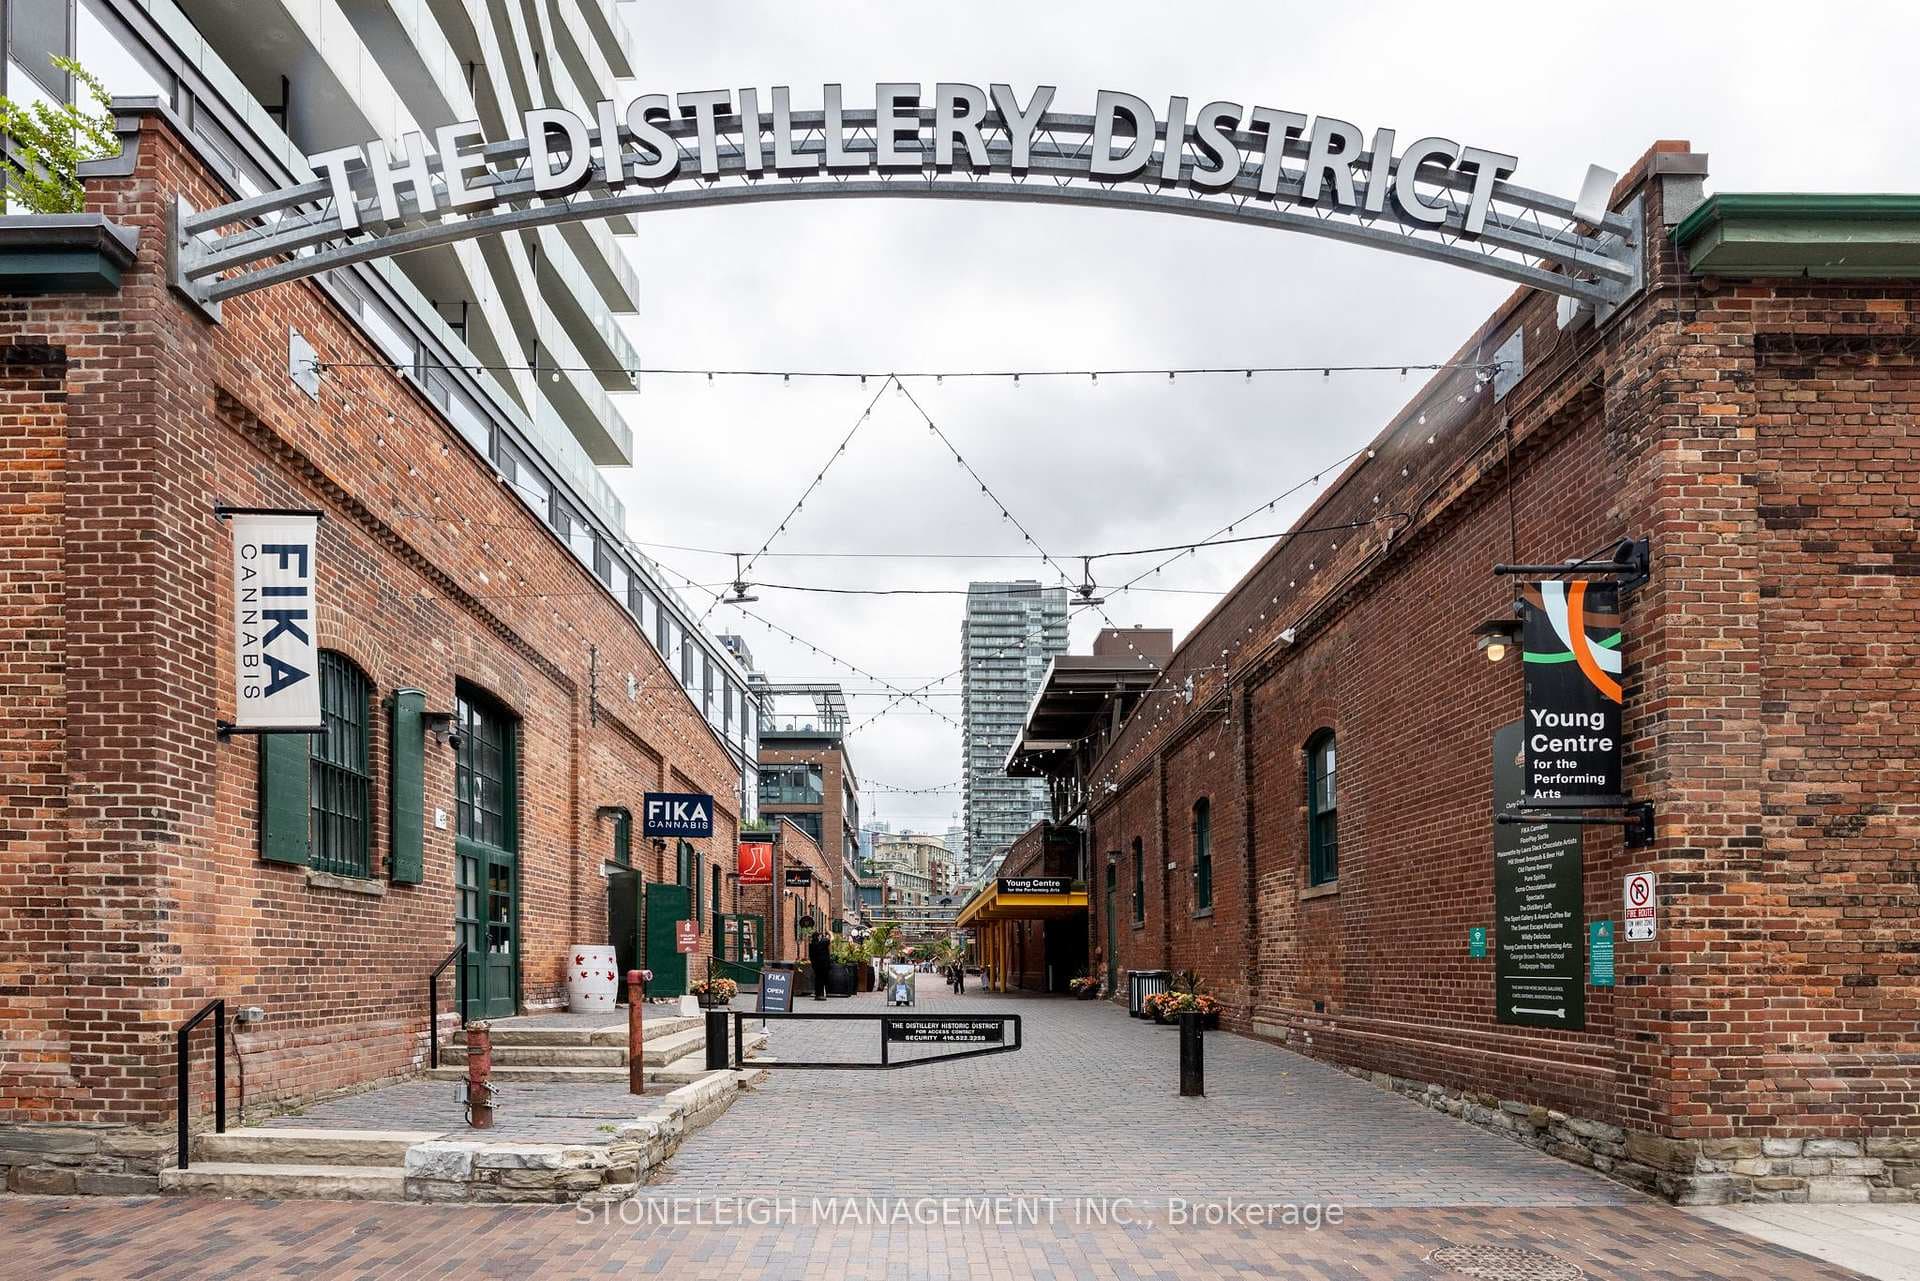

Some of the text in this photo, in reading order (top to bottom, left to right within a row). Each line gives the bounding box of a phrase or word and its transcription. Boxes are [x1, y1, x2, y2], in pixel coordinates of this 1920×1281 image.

[307, 83, 1518, 236] THE DISTILLERY DISTRICT
[241, 544, 260, 699] CANNABIS
[262, 544, 311, 698] FIKA
[1530, 709, 1605, 731] Young
[1531, 734, 1613, 752] Centre
[1534, 759, 1577, 769] for the
[1534, 773, 1605, 785] Performing
[1534, 789, 1561, 799] Arts
[649, 801, 709, 821] FIKA
[648, 820, 708, 829] CANNABIS
[1626, 908, 1654, 918] FIRE ROUTE
[768, 974, 785, 982] FIKA
